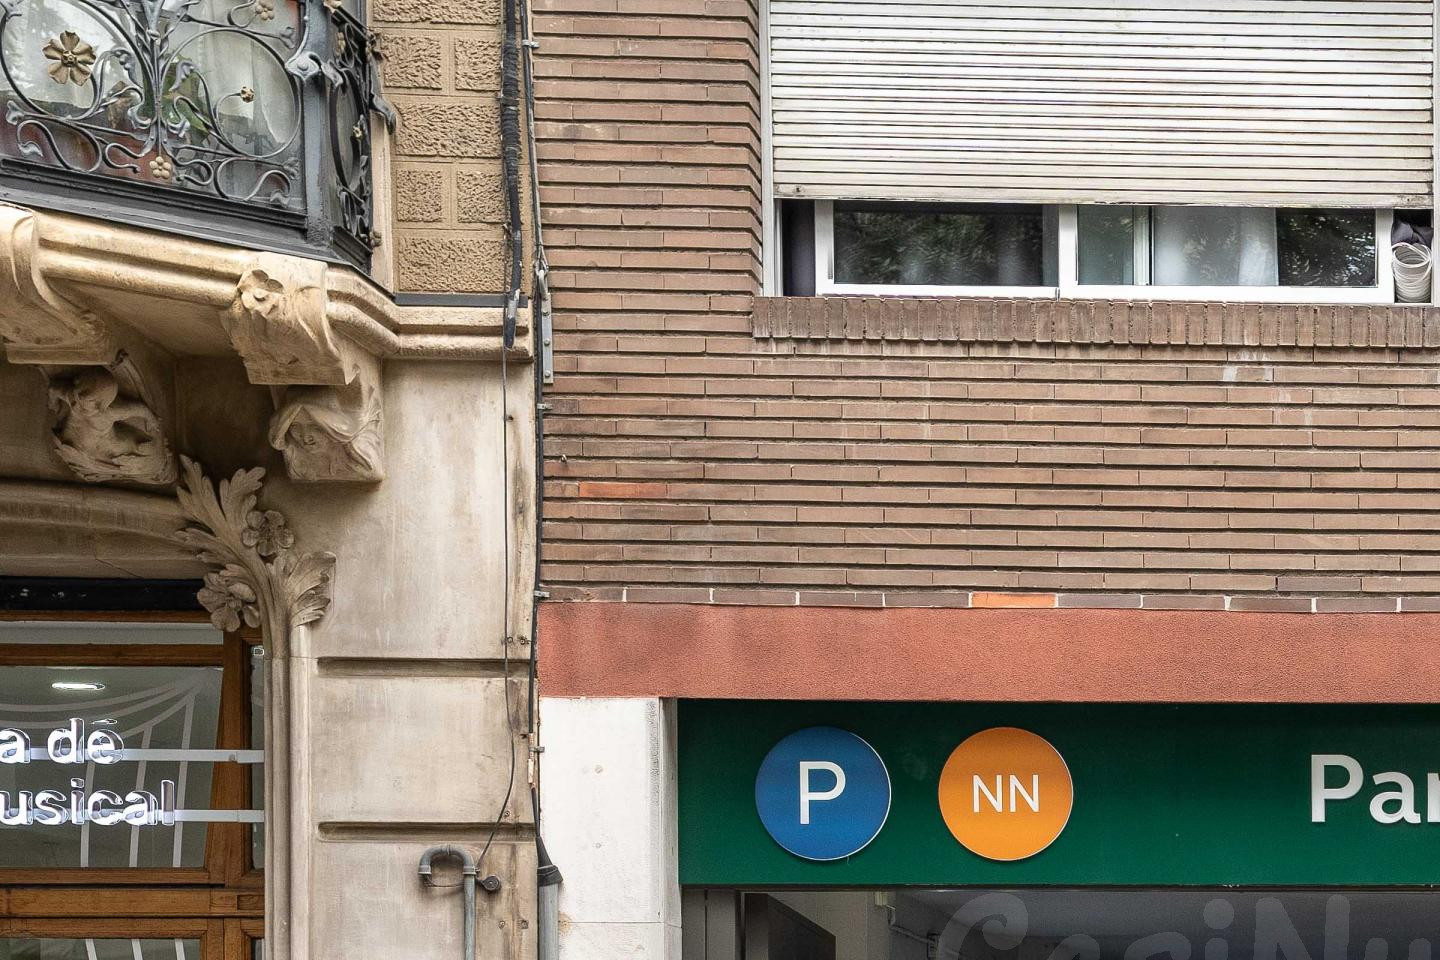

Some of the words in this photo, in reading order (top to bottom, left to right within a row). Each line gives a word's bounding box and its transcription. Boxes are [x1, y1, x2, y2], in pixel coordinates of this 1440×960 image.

[47, 717, 124, 764] de
[0, 777, 176, 826] usical
[799, 761, 847, 825] P
[972, 774, 1040, 813] NN
